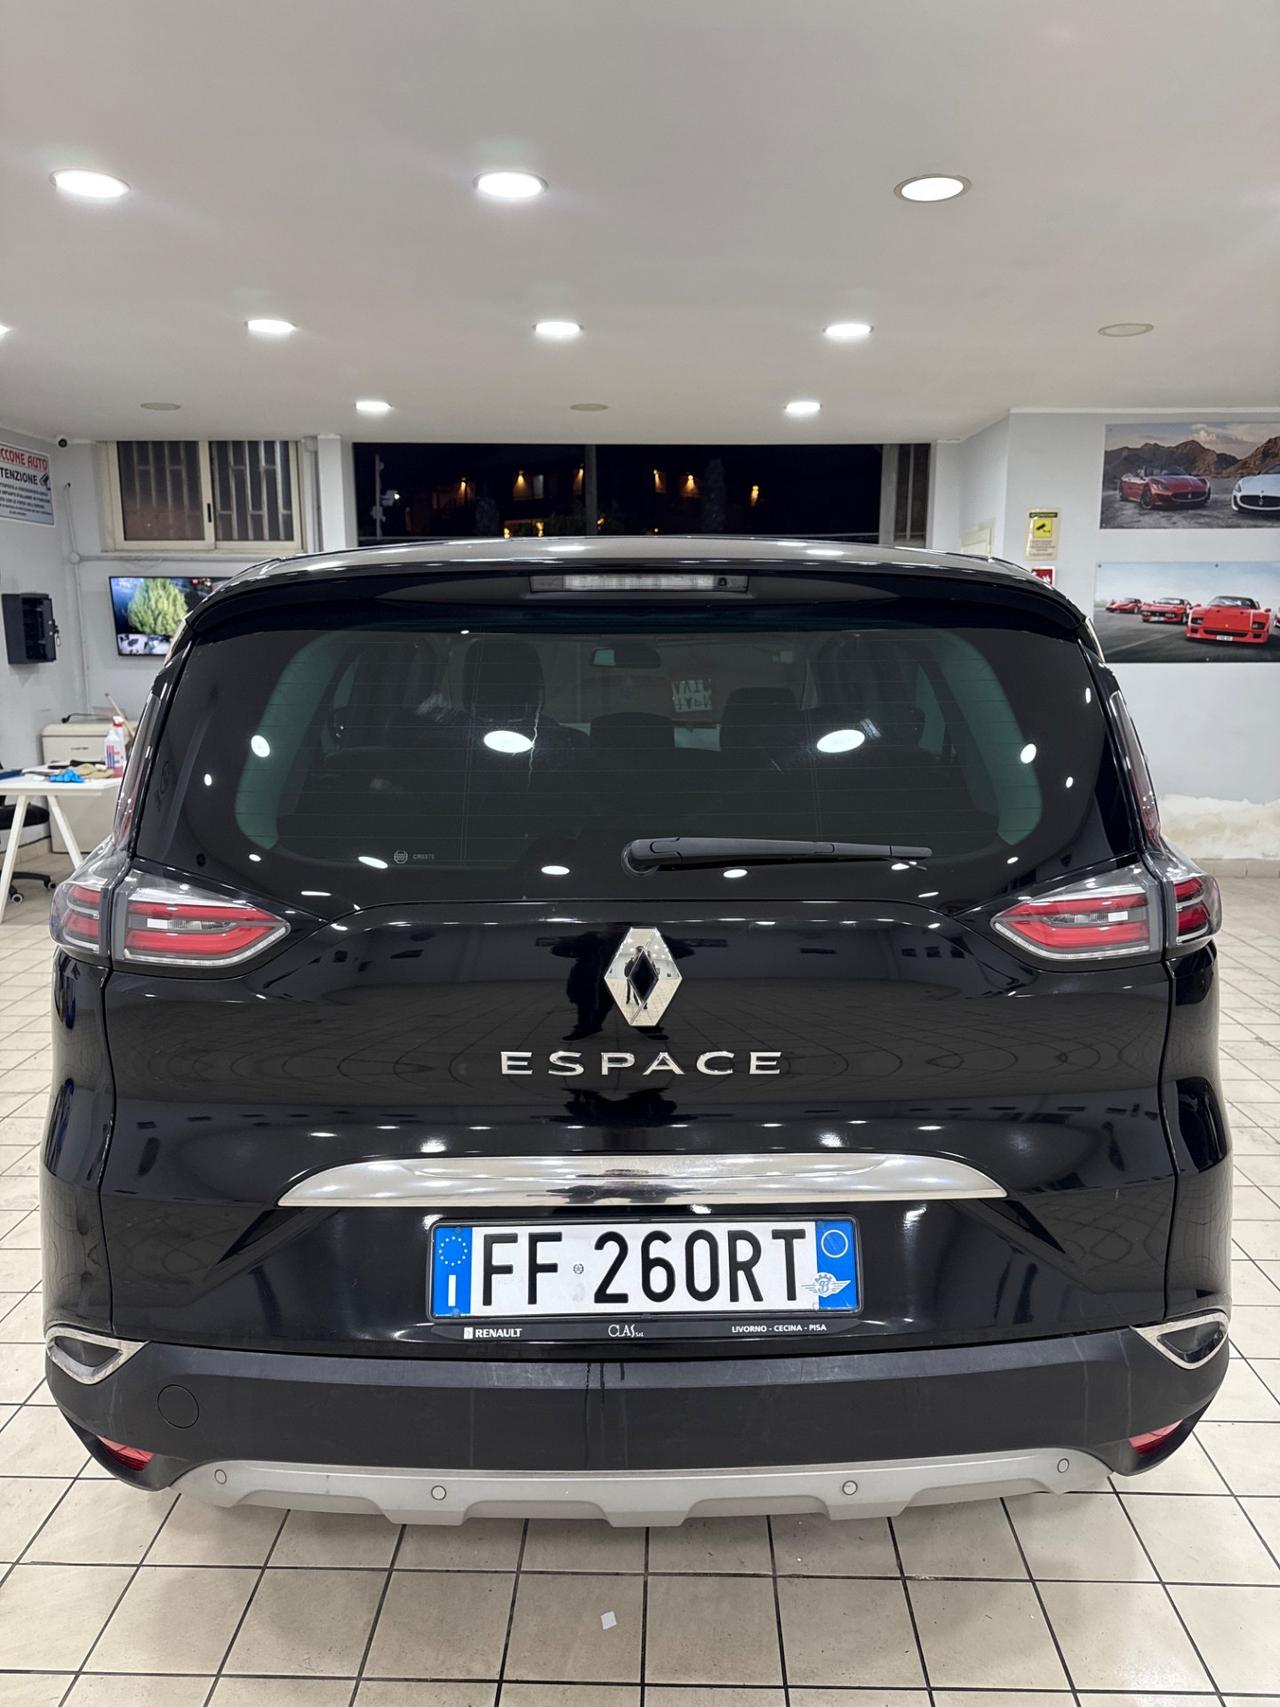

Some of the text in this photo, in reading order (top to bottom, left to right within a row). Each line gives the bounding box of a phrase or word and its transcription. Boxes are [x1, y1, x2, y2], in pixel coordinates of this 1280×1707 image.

[27, 455, 48, 471] AUTO
[500, 1050, 783, 1076] ESPACE
[482, 1229, 806, 1306] FF 260RT
[448, 1274, 457, 1307] I
[475, 1328, 523, 1338] RENAULT
[731, 1325, 768, 1334] LIVORNO
[773, 1324, 803, 1332] CECINA
[808, 1323, 828, 1331] PISA
